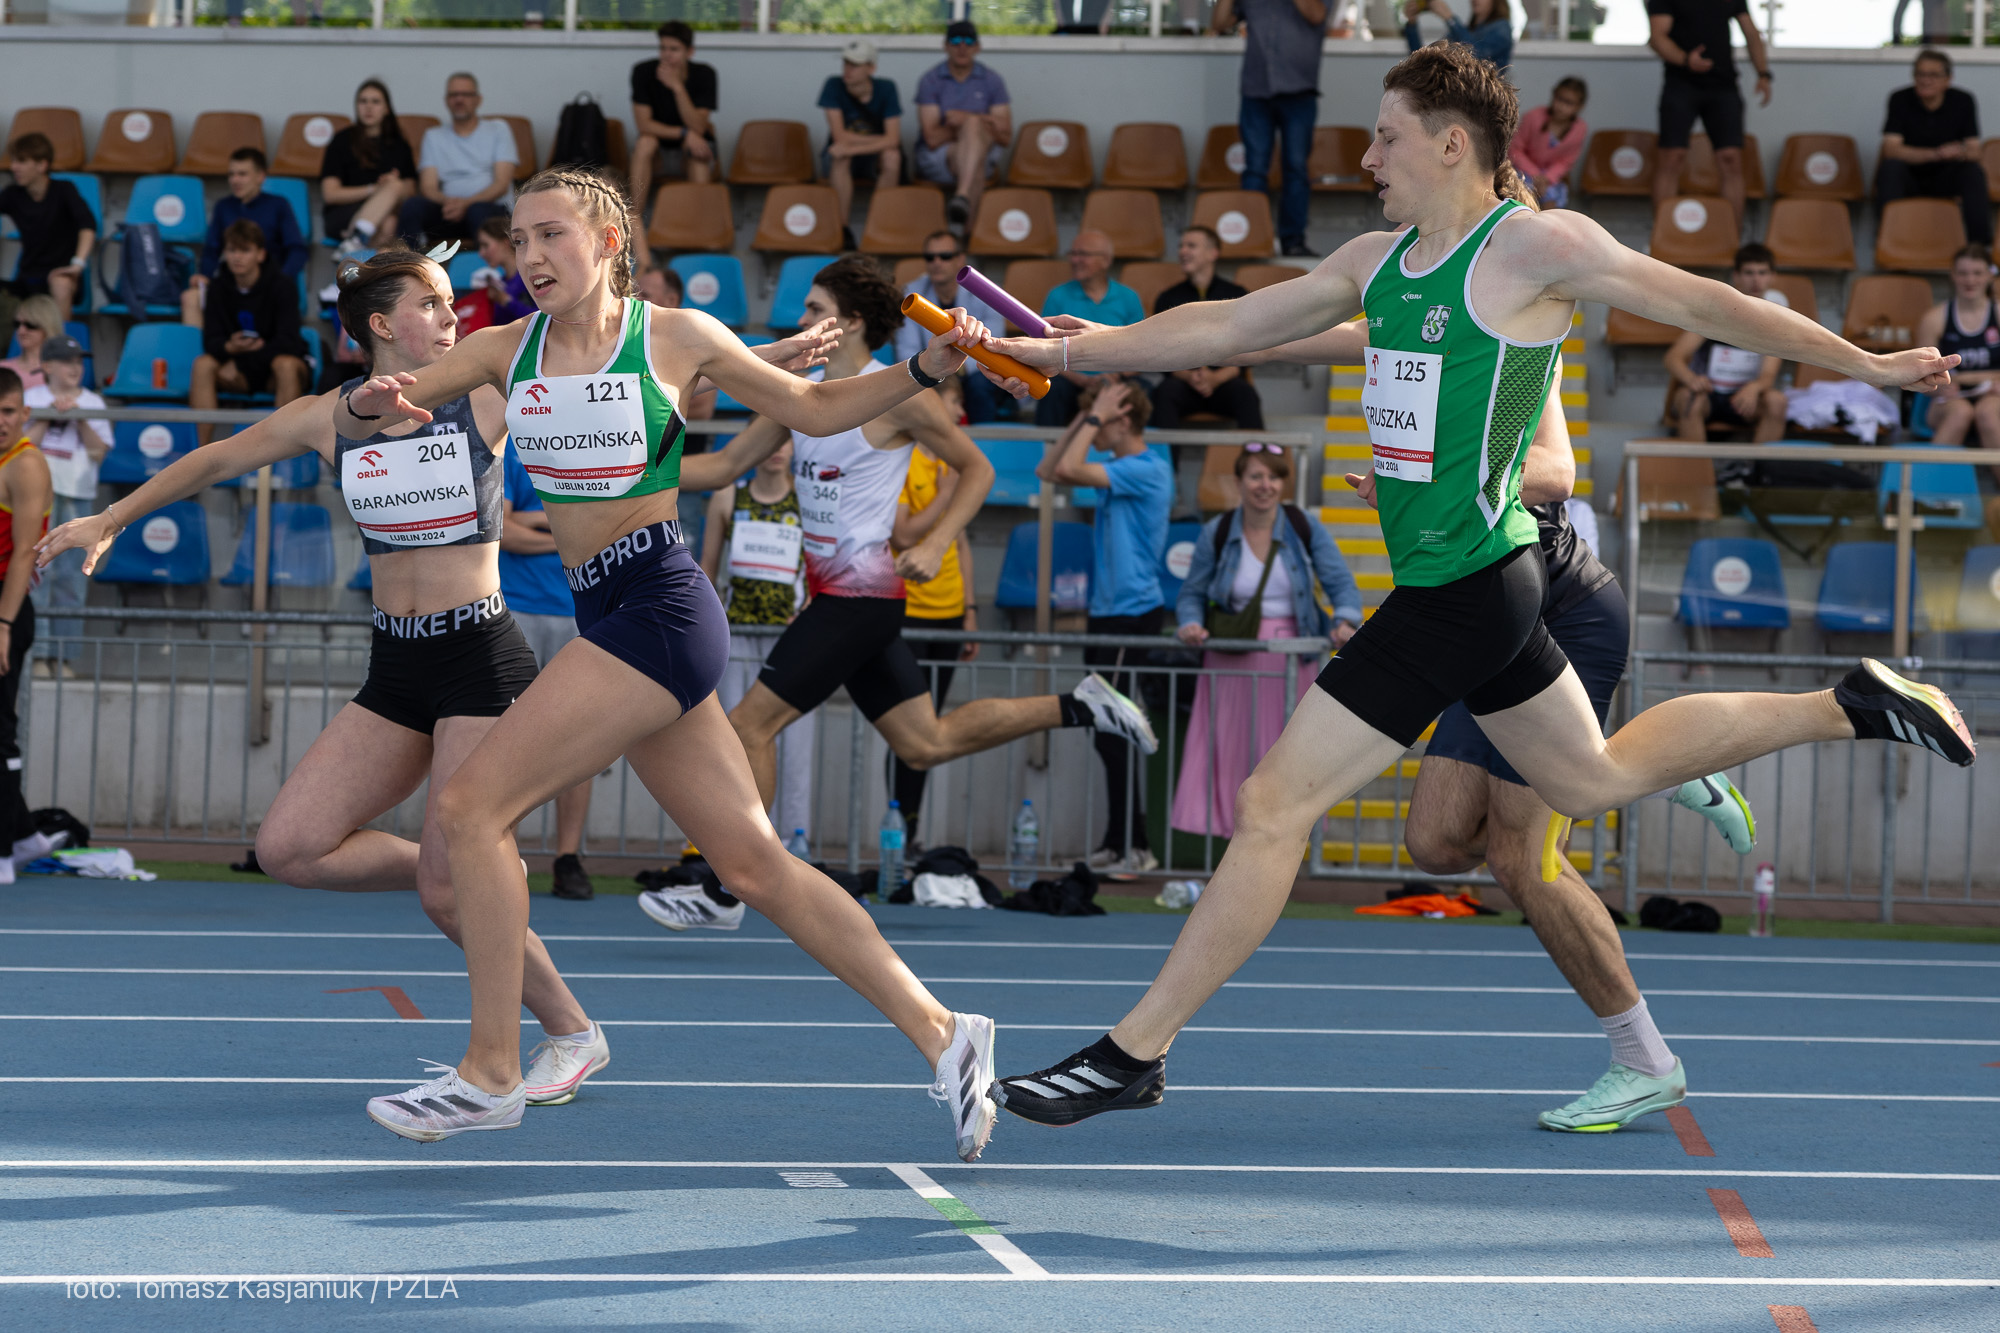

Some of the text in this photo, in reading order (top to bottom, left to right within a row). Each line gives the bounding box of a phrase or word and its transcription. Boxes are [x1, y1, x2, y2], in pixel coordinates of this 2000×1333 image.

[1394, 360, 1426, 382] 125
[585, 382, 628, 402] 121
[520, 406, 552, 416] ORLEN
[515, 430, 644, 451] CZWODZIŃSKA
[418, 442, 457, 464] 204
[357, 468, 388, 479] ORLEN
[612, 466, 644, 475] MIESZANYCH
[554, 482, 610, 491] LUBLIN 2024
[813, 486, 838, 500] 346
[352, 484, 468, 510] BARANOWSKA
[446, 514, 474, 525] MIESZANYCH
[390, 531, 446, 542] LUBLIN 2024
[564, 558, 600, 592] NIKE
[600, 528, 652, 576] PRO
[390, 612, 448, 638] NIKE
[454, 591, 502, 630] PRO
